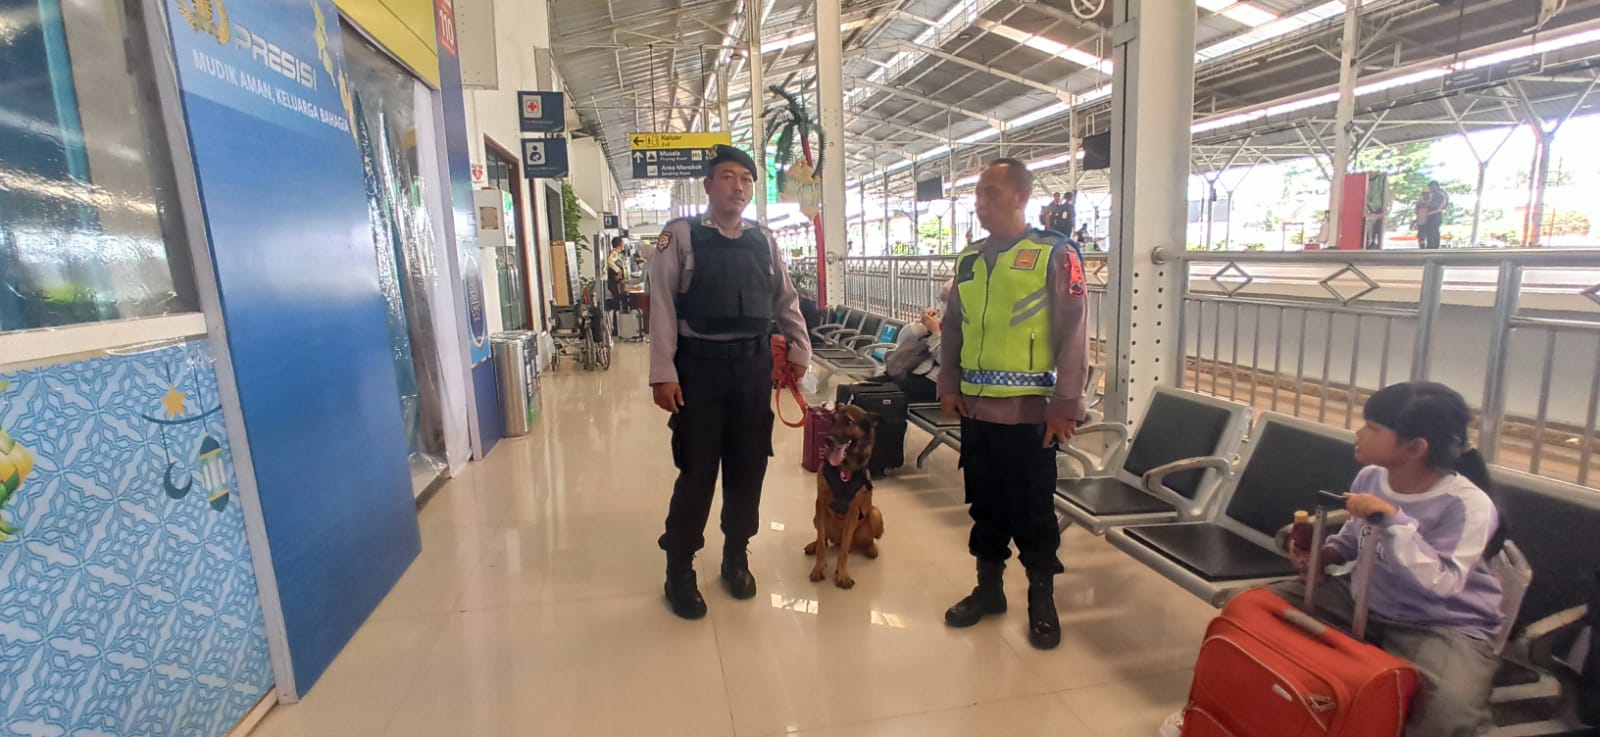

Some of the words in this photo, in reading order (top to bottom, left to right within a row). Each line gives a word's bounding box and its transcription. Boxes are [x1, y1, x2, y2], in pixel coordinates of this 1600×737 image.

[235, 23, 316, 89] PRESISI
[440, 9, 454, 46] 110
[192, 48, 239, 87] MUDIK
[241, 71, 277, 104] AMAN,
[275, 87, 320, 120] KELUARGA
[320, 107, 351, 134] BAHAGIA
